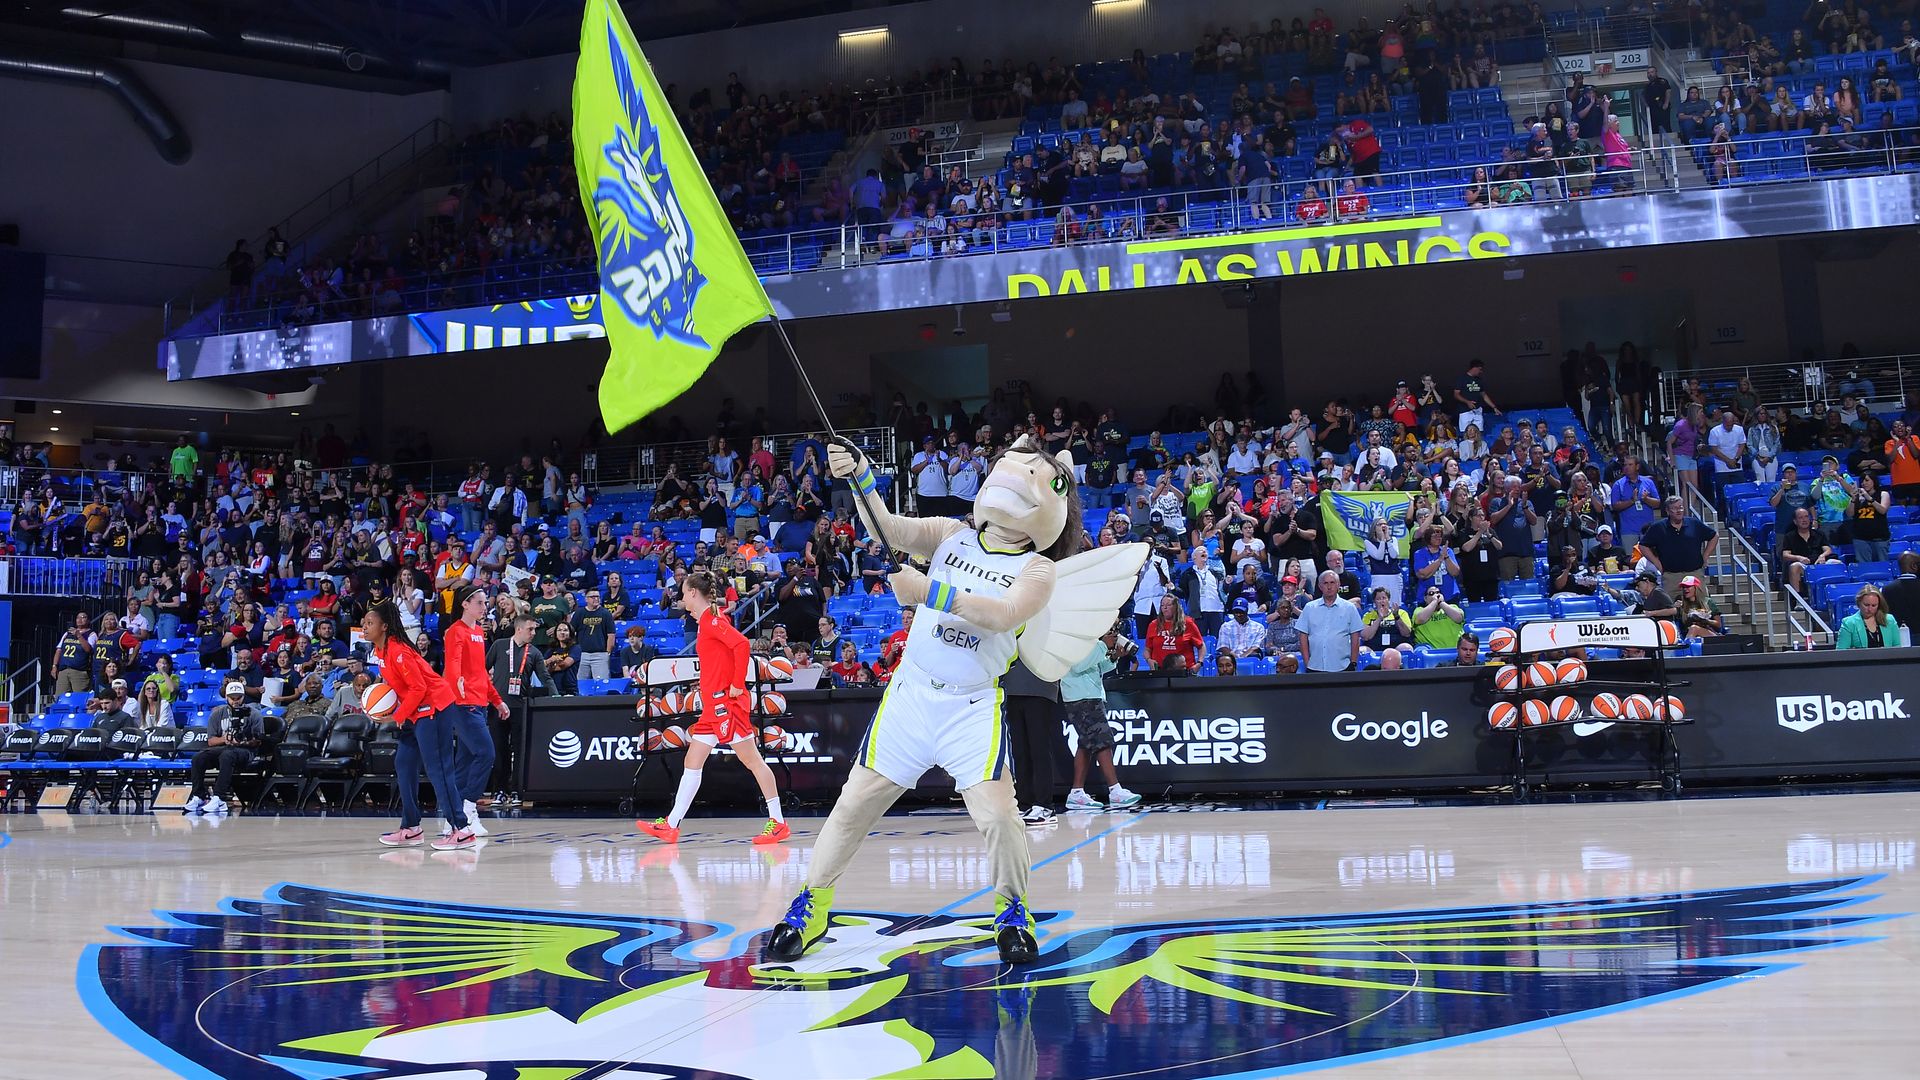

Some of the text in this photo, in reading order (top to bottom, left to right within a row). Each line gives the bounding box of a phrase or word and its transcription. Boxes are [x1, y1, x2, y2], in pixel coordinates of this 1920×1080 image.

[1564, 59, 1584, 69] 202
[1621, 54, 1641, 64] 203
[889, 131, 907, 141] 201
[1007, 253, 1258, 299] DALLAS
[1717, 327, 1737, 338] 103
[1524, 340, 1544, 351] 102
[1858, 508, 1875, 519] 22
[944, 553, 1015, 588] WINGS
[589, 625, 595, 635] 7
[1577, 623, 1630, 637] Wilson
[943, 627, 981, 652] GEM
[1164, 636, 1176, 645] 22
[63, 645, 76, 658] 22
[96, 647, 107, 659] 22
[1108, 717, 1266, 743] CHANGE
[1331, 711, 1449, 747] Google
[49, 735, 68, 743] AT&T
[122, 734, 142, 743] AT&T
[151, 735, 175, 743] WNBA
[1110, 740, 1267, 766] MAKERS
